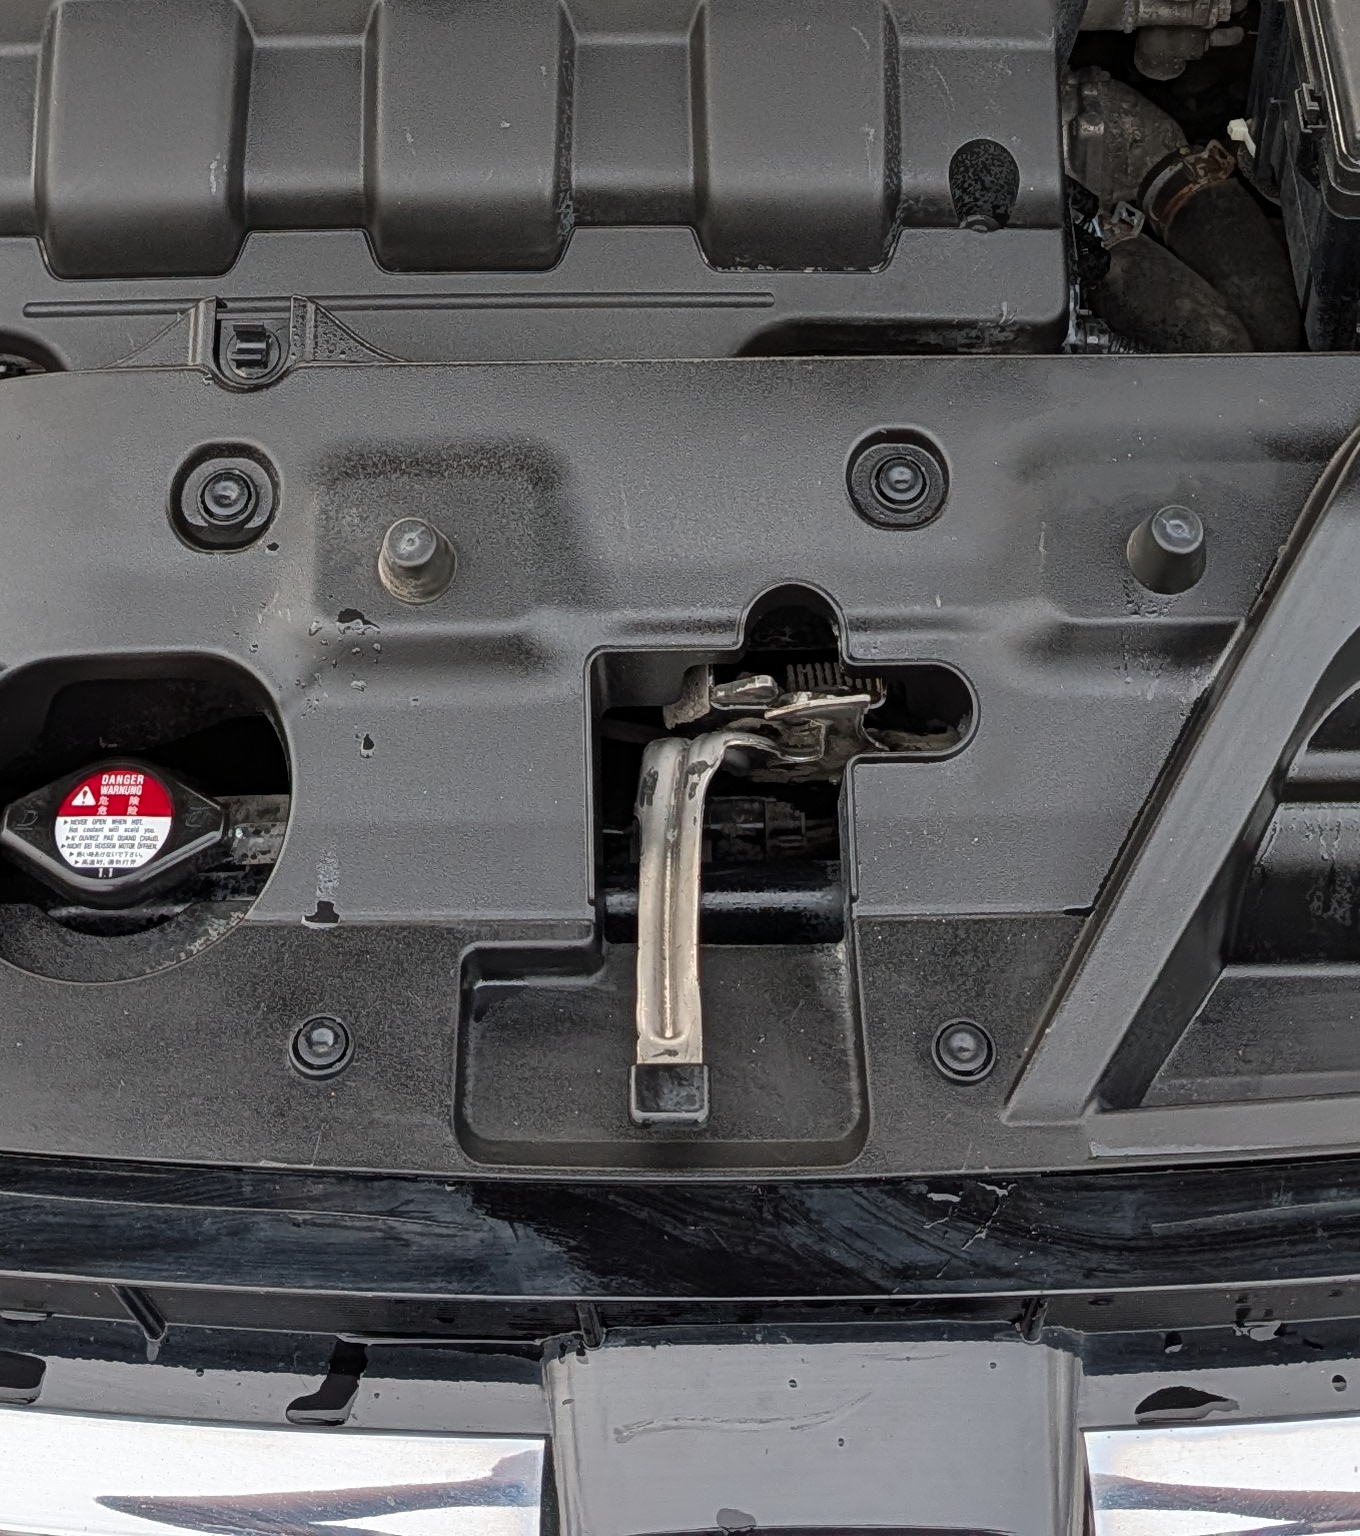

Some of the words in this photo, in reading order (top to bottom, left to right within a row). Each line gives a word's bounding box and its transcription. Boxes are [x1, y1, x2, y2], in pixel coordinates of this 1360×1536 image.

[101, 774, 145, 785] DANGER
[100, 785, 143, 796] WARNUNG
[98, 867, 113, 878] 1.1
